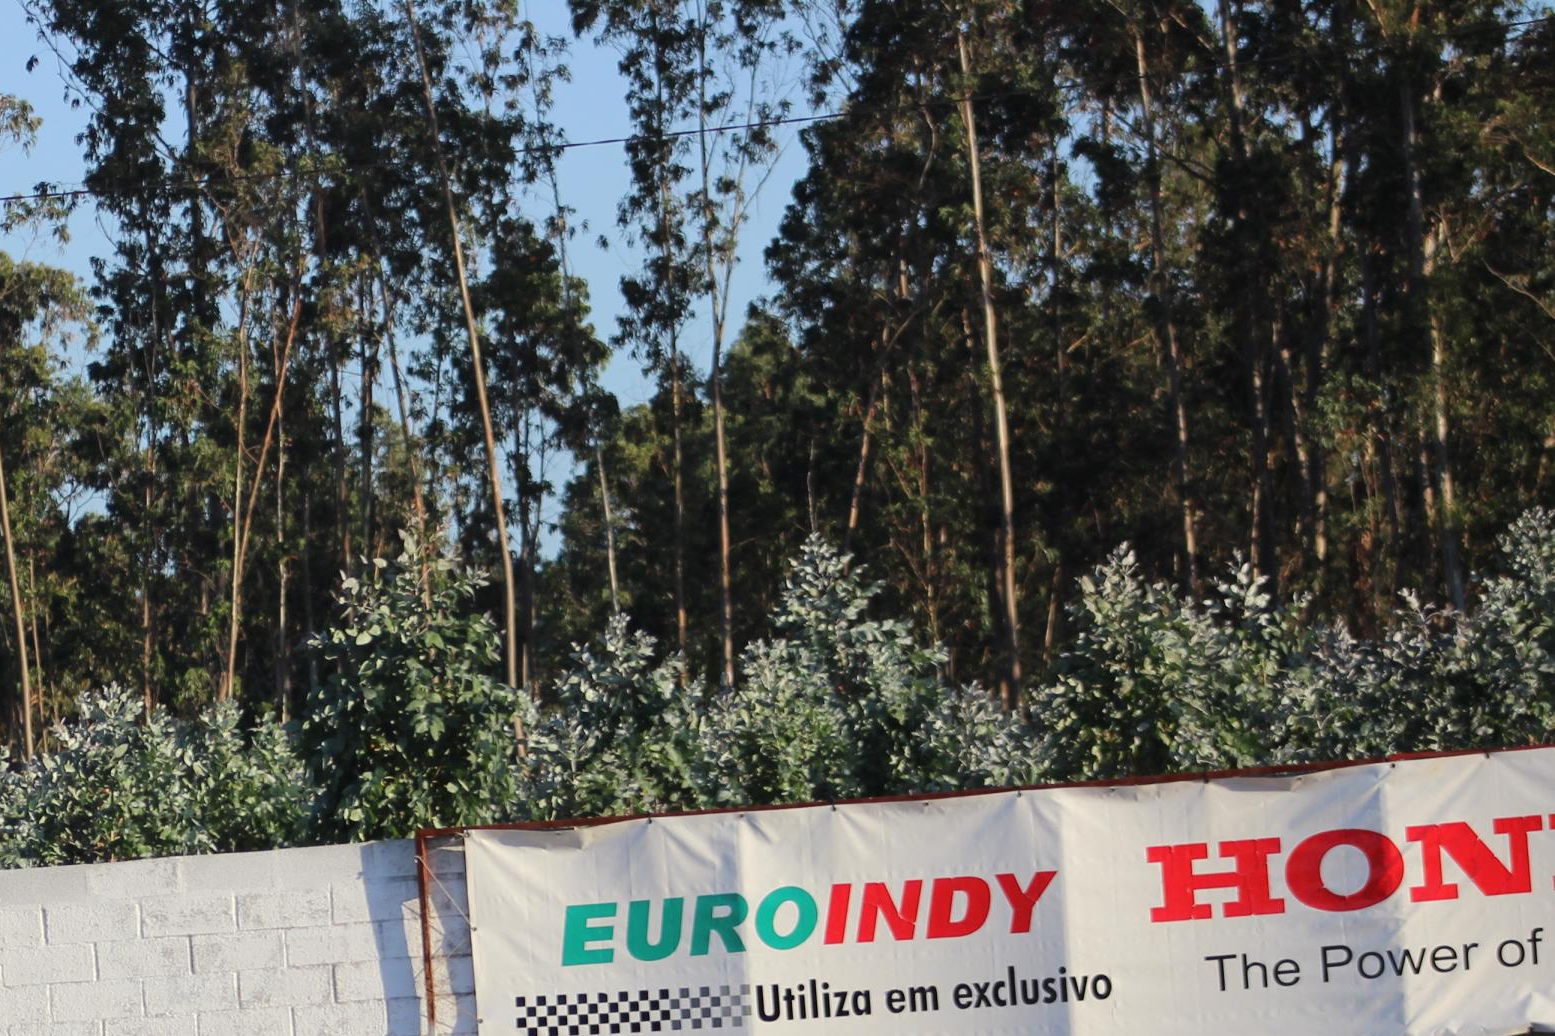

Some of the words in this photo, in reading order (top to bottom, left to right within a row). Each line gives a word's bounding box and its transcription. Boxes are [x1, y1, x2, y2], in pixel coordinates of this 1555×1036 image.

[1146, 813, 1555, 923] HON
[561, 870, 1058, 966] EUROINDY
[755, 979, 872, 1022] Utiliza
[885, 984, 939, 1013] em
[953, 966, 1112, 1010] exclusivo
[1205, 952, 1300, 991] The
[1321, 942, 1478, 984] Power
[1497, 927, 1544, 967] of
